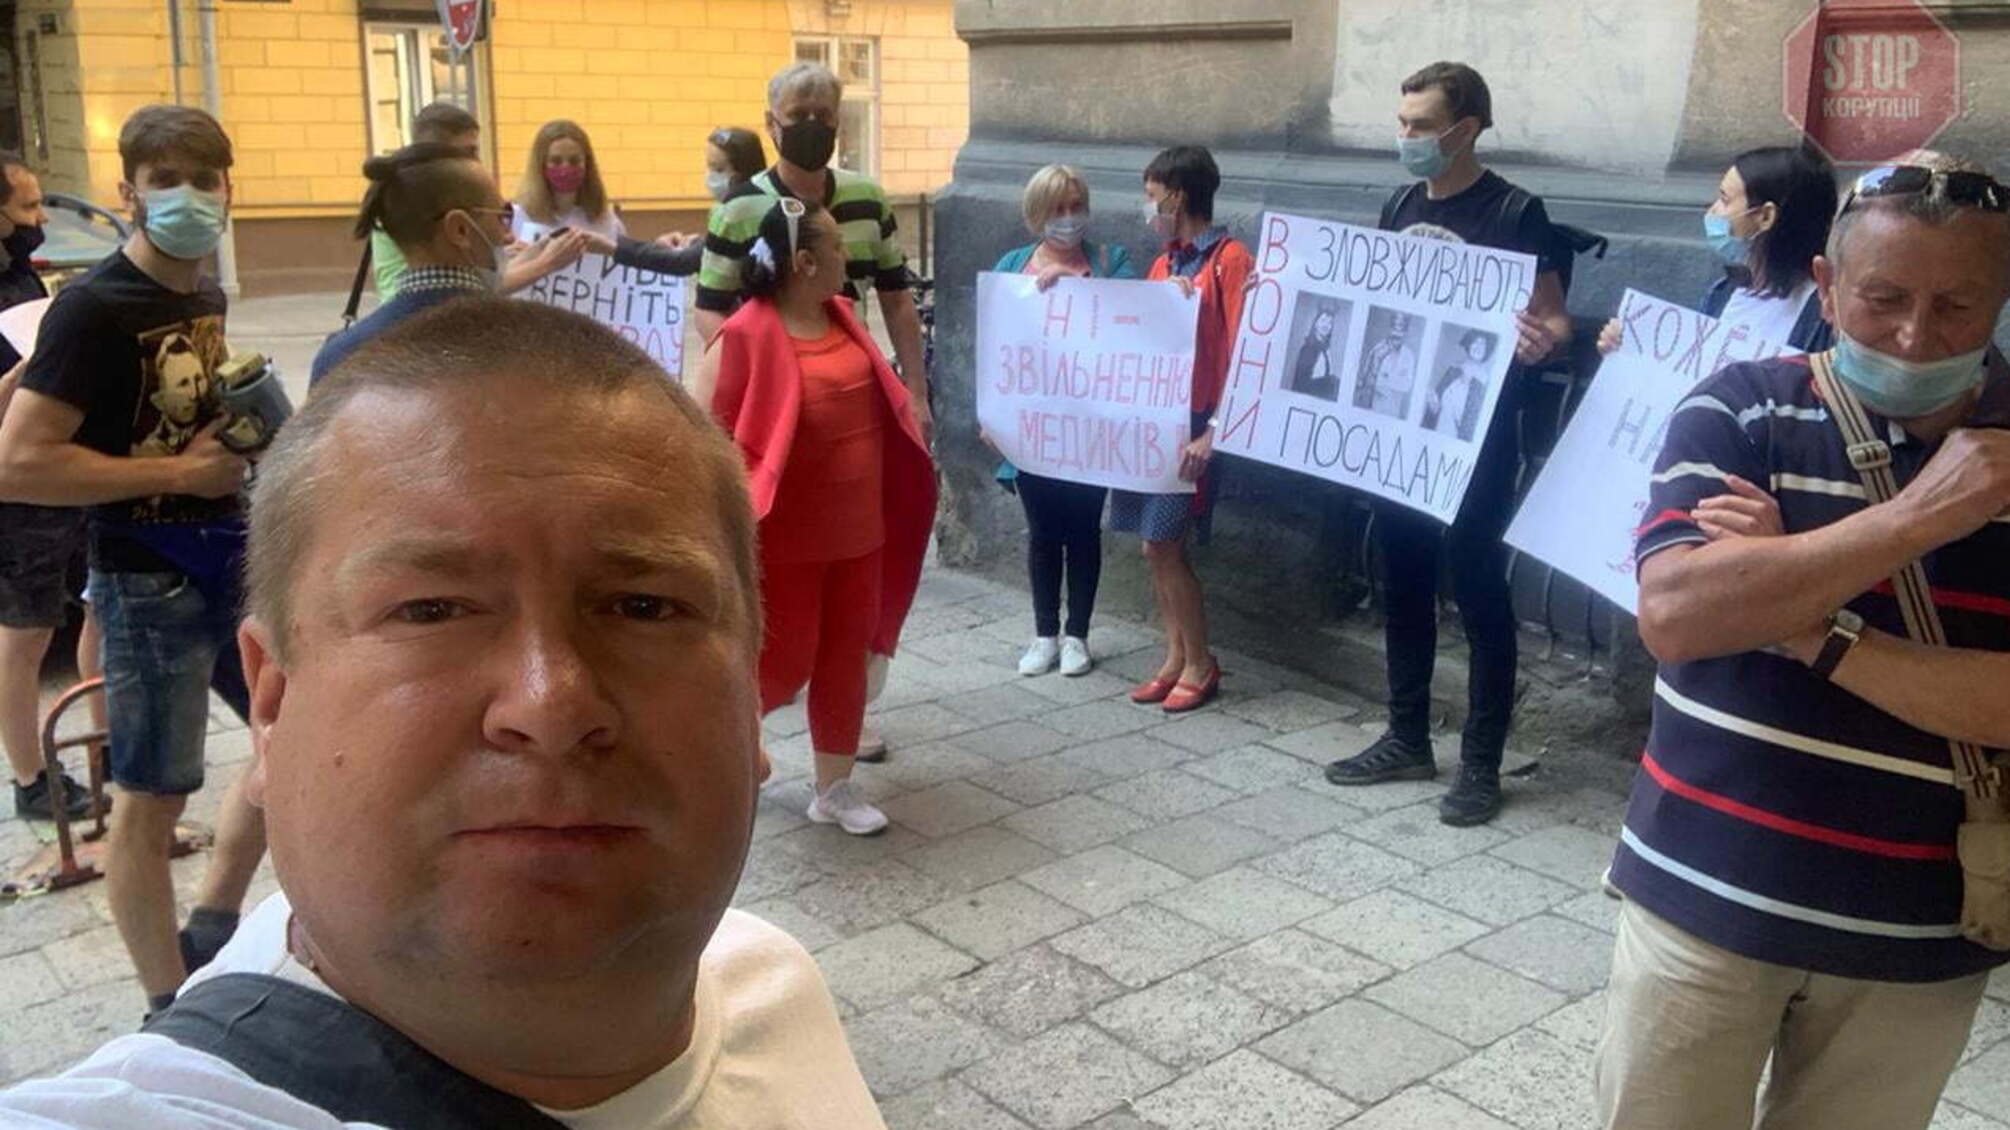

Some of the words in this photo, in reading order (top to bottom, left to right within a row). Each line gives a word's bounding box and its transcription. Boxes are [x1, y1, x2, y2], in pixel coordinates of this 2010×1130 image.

[1305, 226, 1530, 314] ЗЛОВЖИВАЮТЬ
[996, 341, 1192, 409] ЗВІЛЬНЕННЮ
[1018, 409, 1167, 478] МЕДИКІВ
